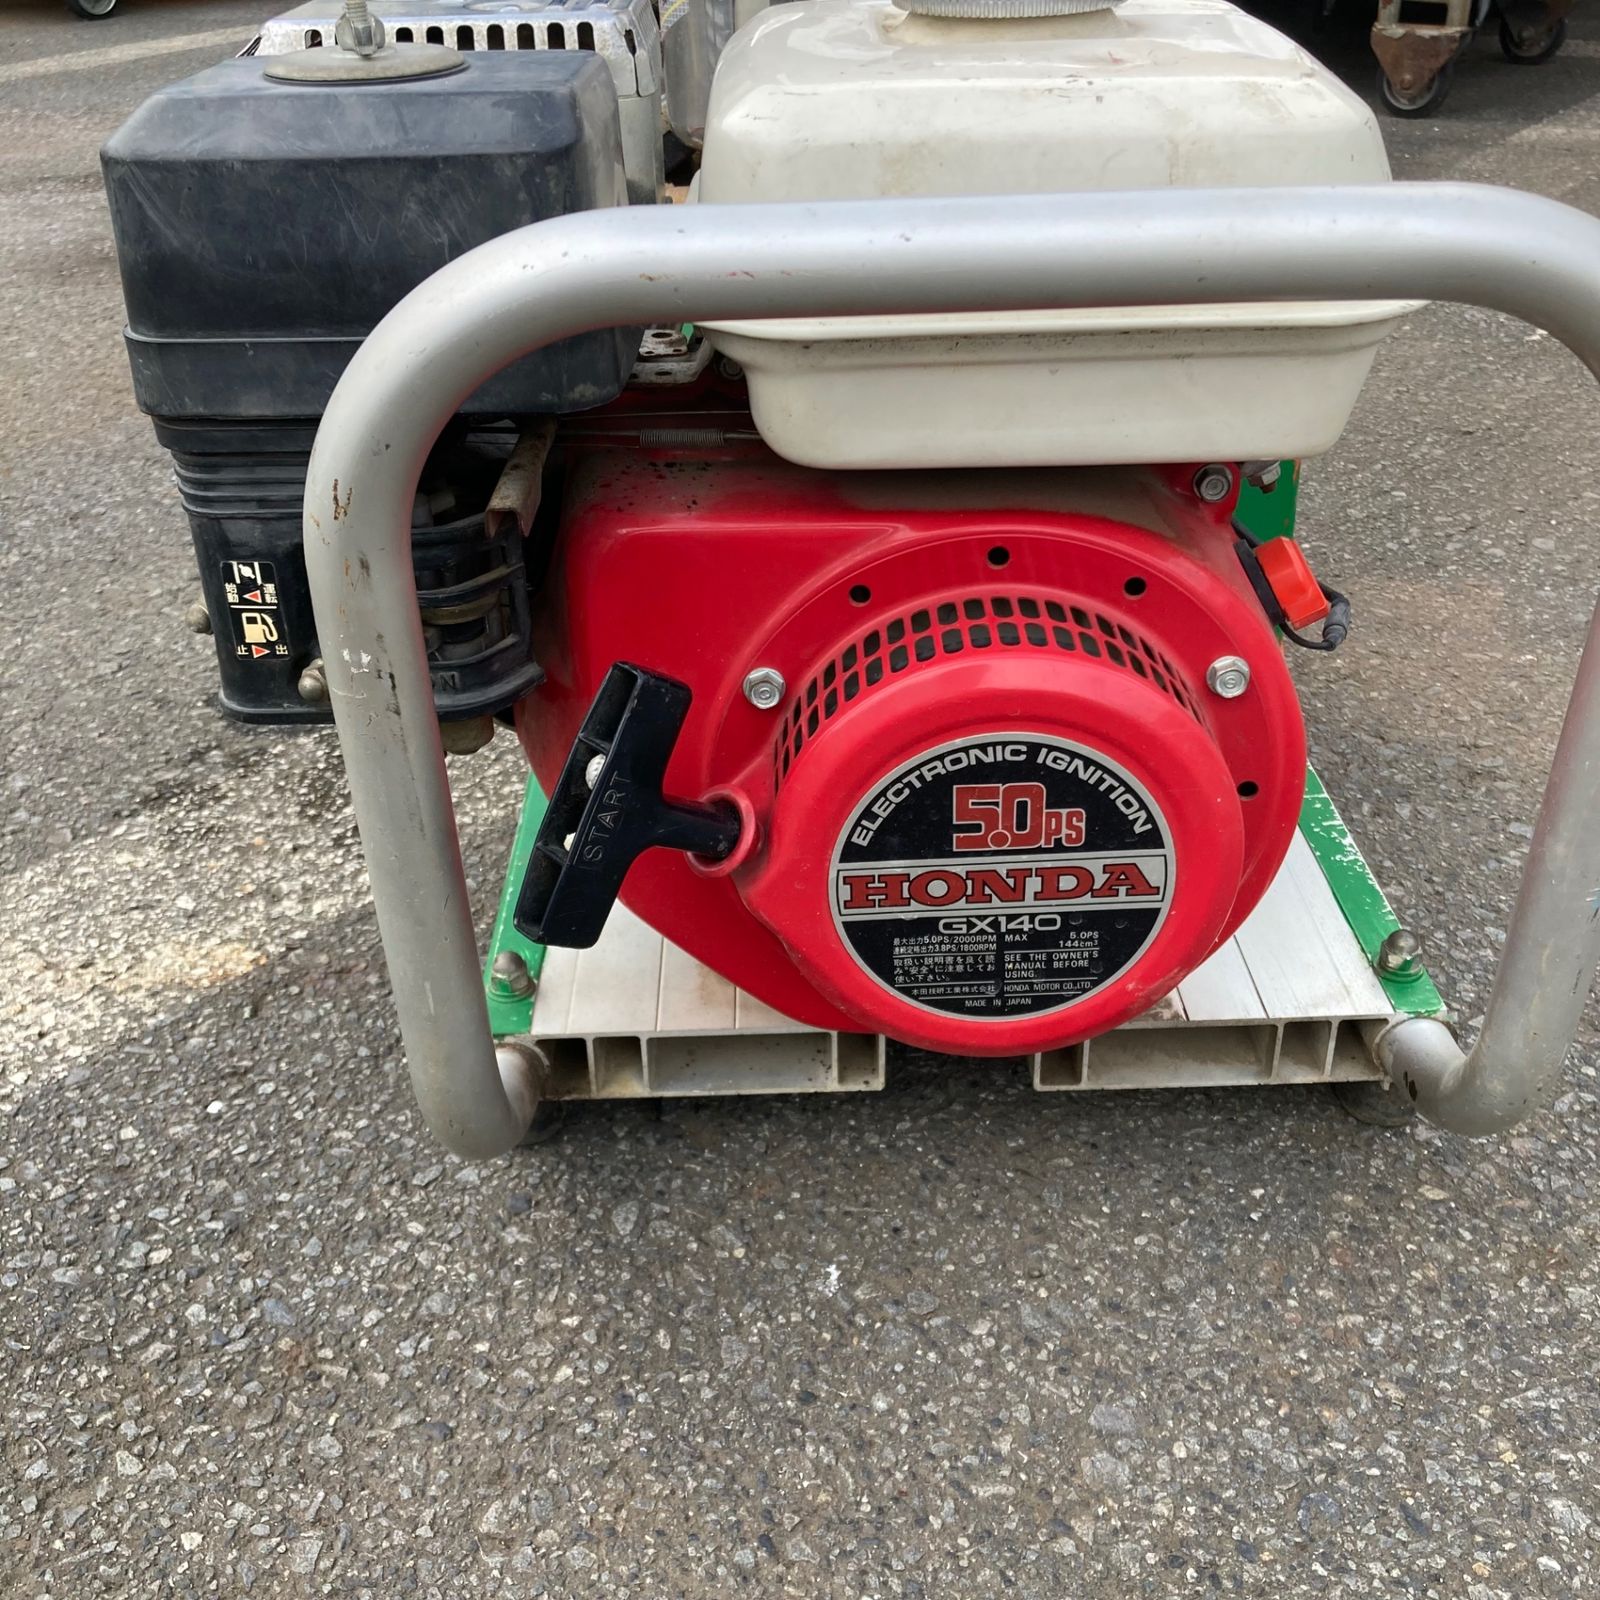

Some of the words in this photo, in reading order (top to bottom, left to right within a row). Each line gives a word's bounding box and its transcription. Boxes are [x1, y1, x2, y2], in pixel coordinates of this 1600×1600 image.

[236, 644, 249, 655] 止
[275, 644, 288, 655] 出
[851, 744, 1028, 847] ELECTRONIC
[1036, 747, 1153, 835] IGNITION
[583, 770, 632, 862] START
[843, 862, 1161, 910] HONDA
[938, 914, 1062, 935] GX140
[1004, 933, 1028, 942] MAX
[1069, 931, 1099, 940] 5.0PS
[1004, 952, 1022, 962] SEE
[1029, 952, 1047, 961] THE
[1052, 950, 1099, 960] OWNER'S
[1004, 961, 1047, 970] MANUAL
[1053, 959, 1089, 969] BEFORE
[1004, 969, 1038, 979] USING.
[1004, 983, 1030, 992] HONDA
[1033, 982, 1060, 992] MOTOR
[964, 999, 987, 1007] MADE
[992, 998, 1002, 1007] IN
[1006, 997, 1032, 1006] JAPAN
